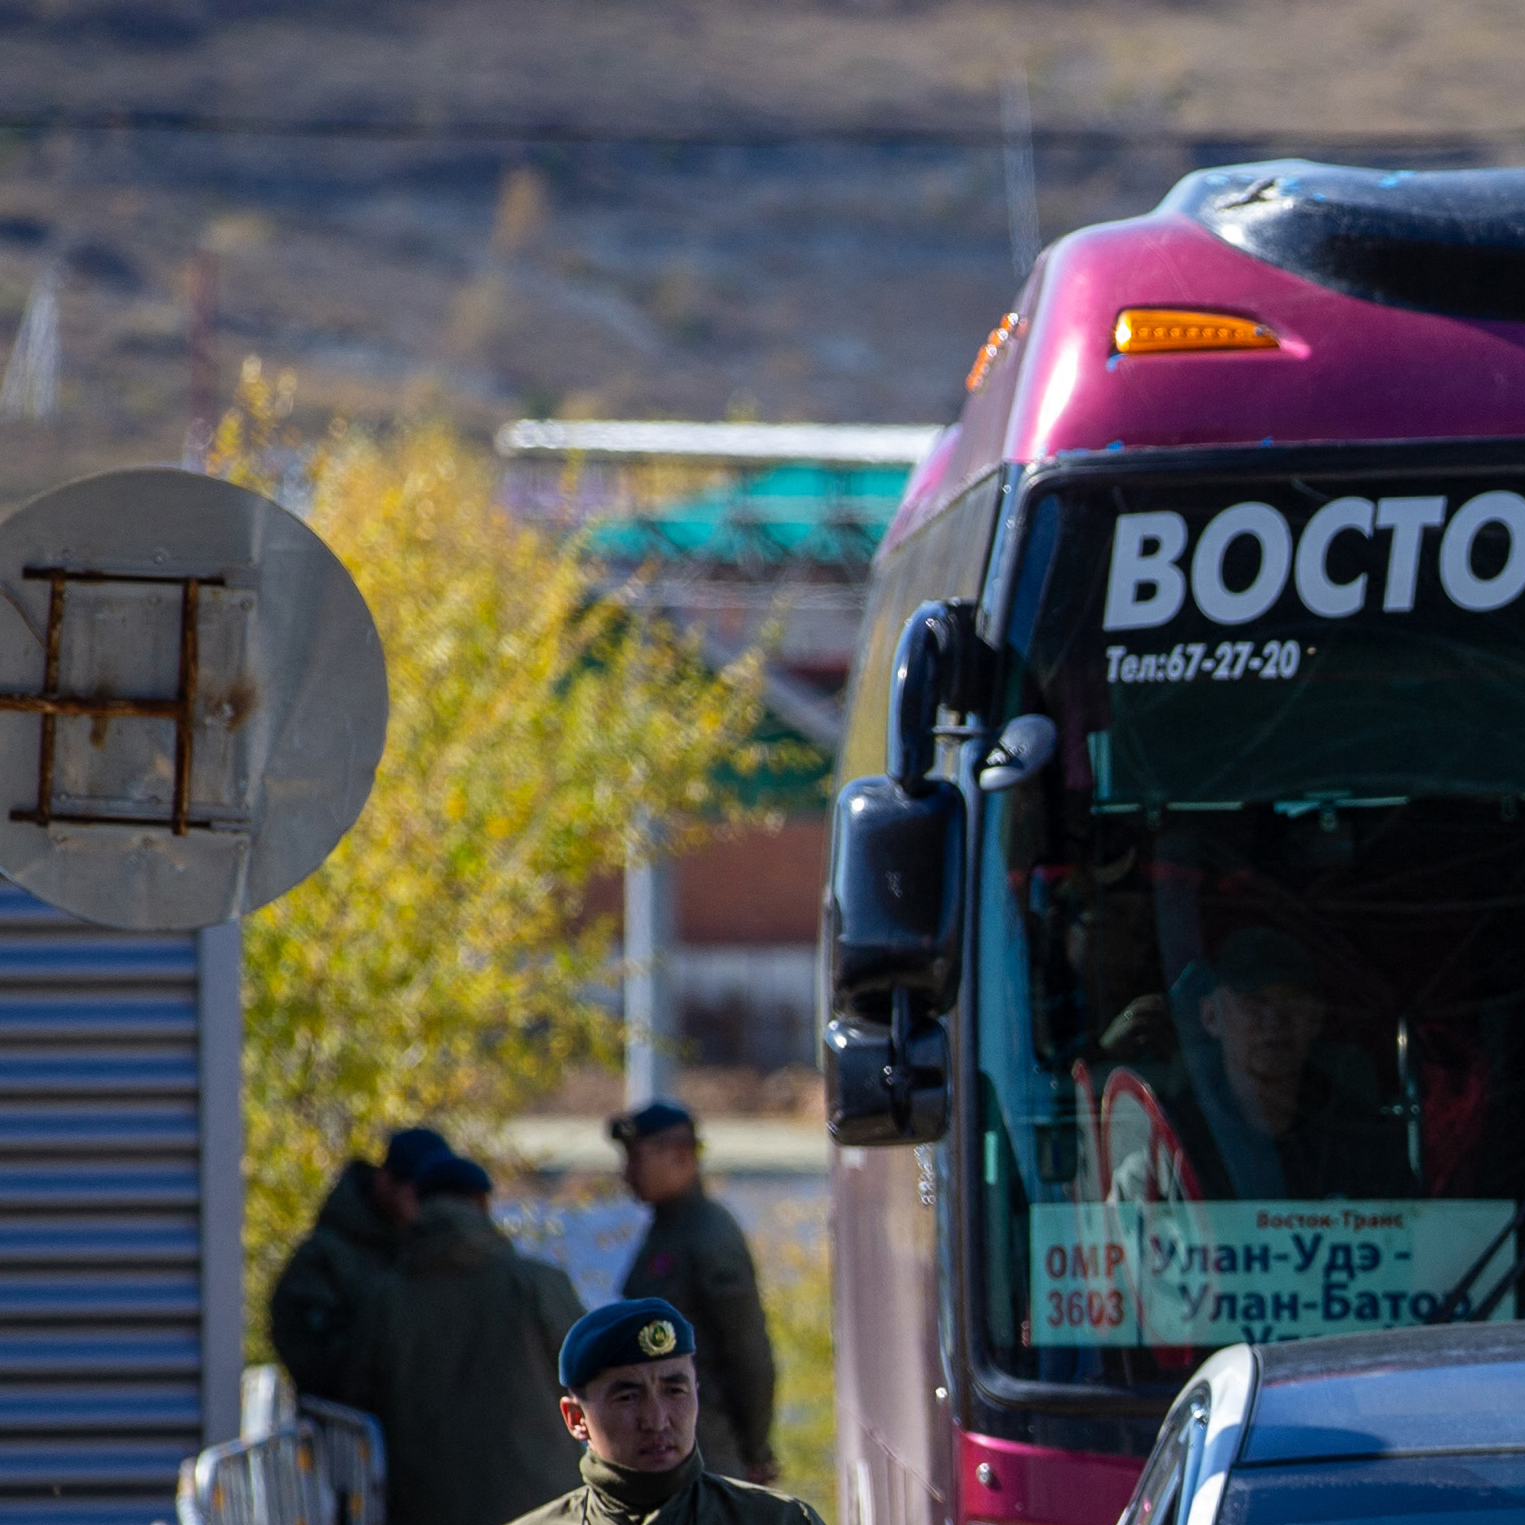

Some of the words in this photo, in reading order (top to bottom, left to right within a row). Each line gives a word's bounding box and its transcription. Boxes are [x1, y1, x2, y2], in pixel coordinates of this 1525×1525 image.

[1106, 640, 1300, 682] Тел:67-27-20
[1150, 1234, 1381, 1280] Улан-Удэ
[1048, 1291, 1125, 1328] 3603
